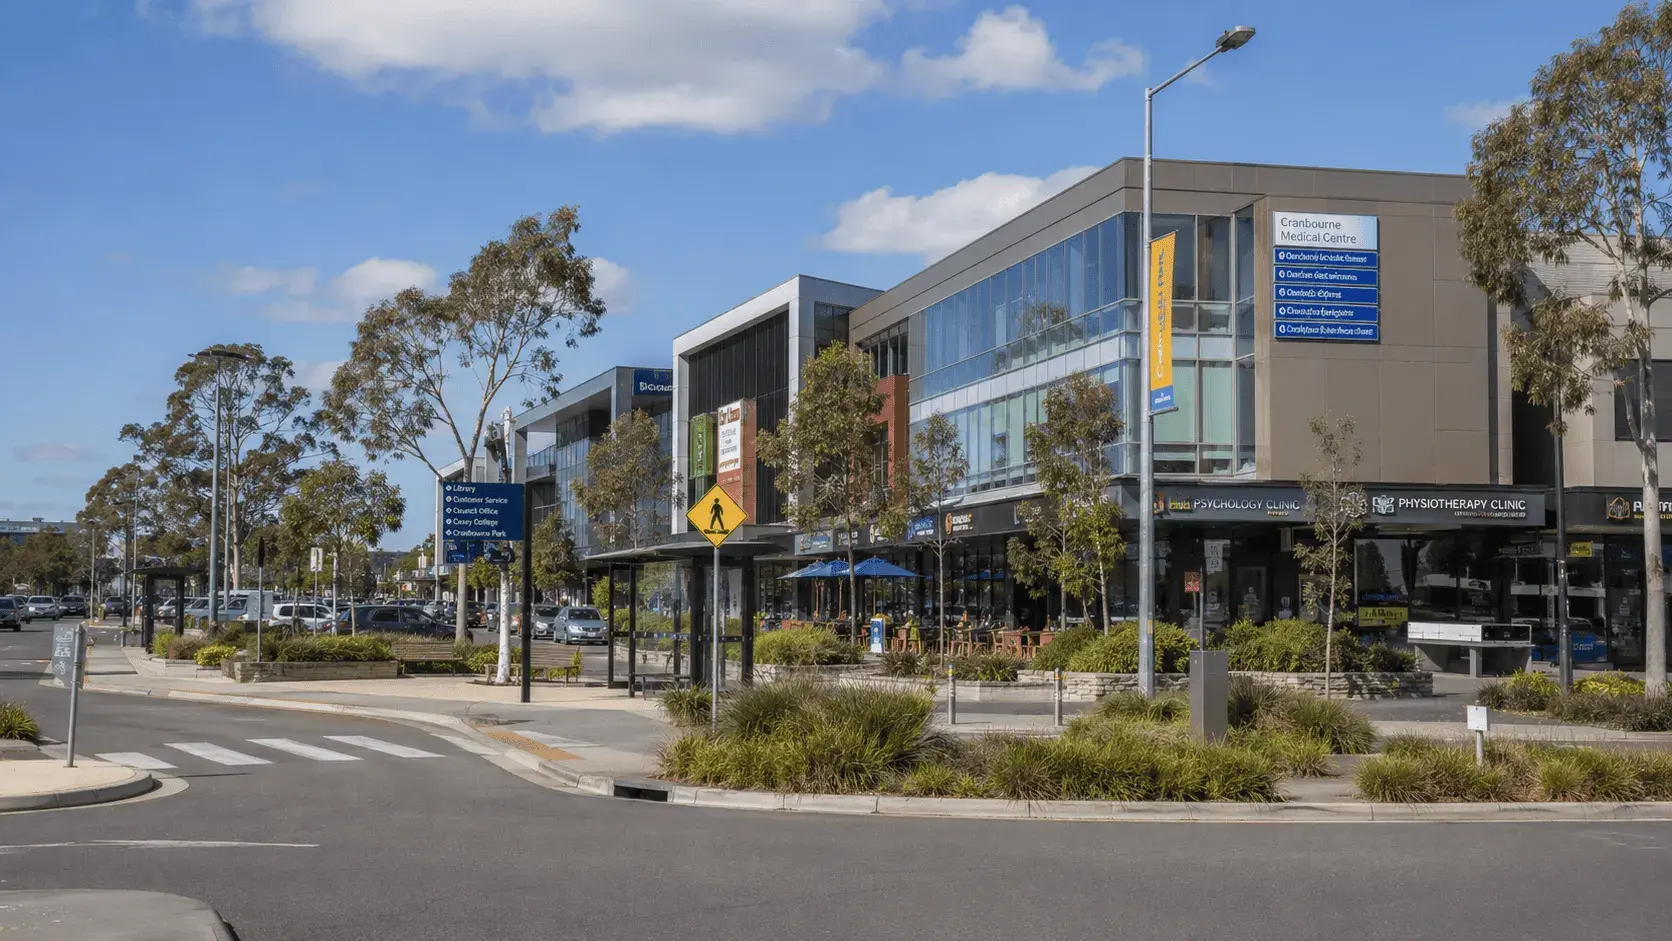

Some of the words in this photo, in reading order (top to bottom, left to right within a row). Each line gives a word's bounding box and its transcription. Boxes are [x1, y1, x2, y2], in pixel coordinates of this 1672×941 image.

[1280, 217, 1341, 230] Cranbourne
[1280, 230, 1320, 243] Medical
[1322, 232, 1357, 244] Centre
[1193, 498, 1263, 510] PSYCHOLOGY
[1266, 499, 1300, 510] CLINIC
[1398, 498, 1487, 510] PHYSIOTHERAPY
[1490, 499, 1526, 510] CLINIC
